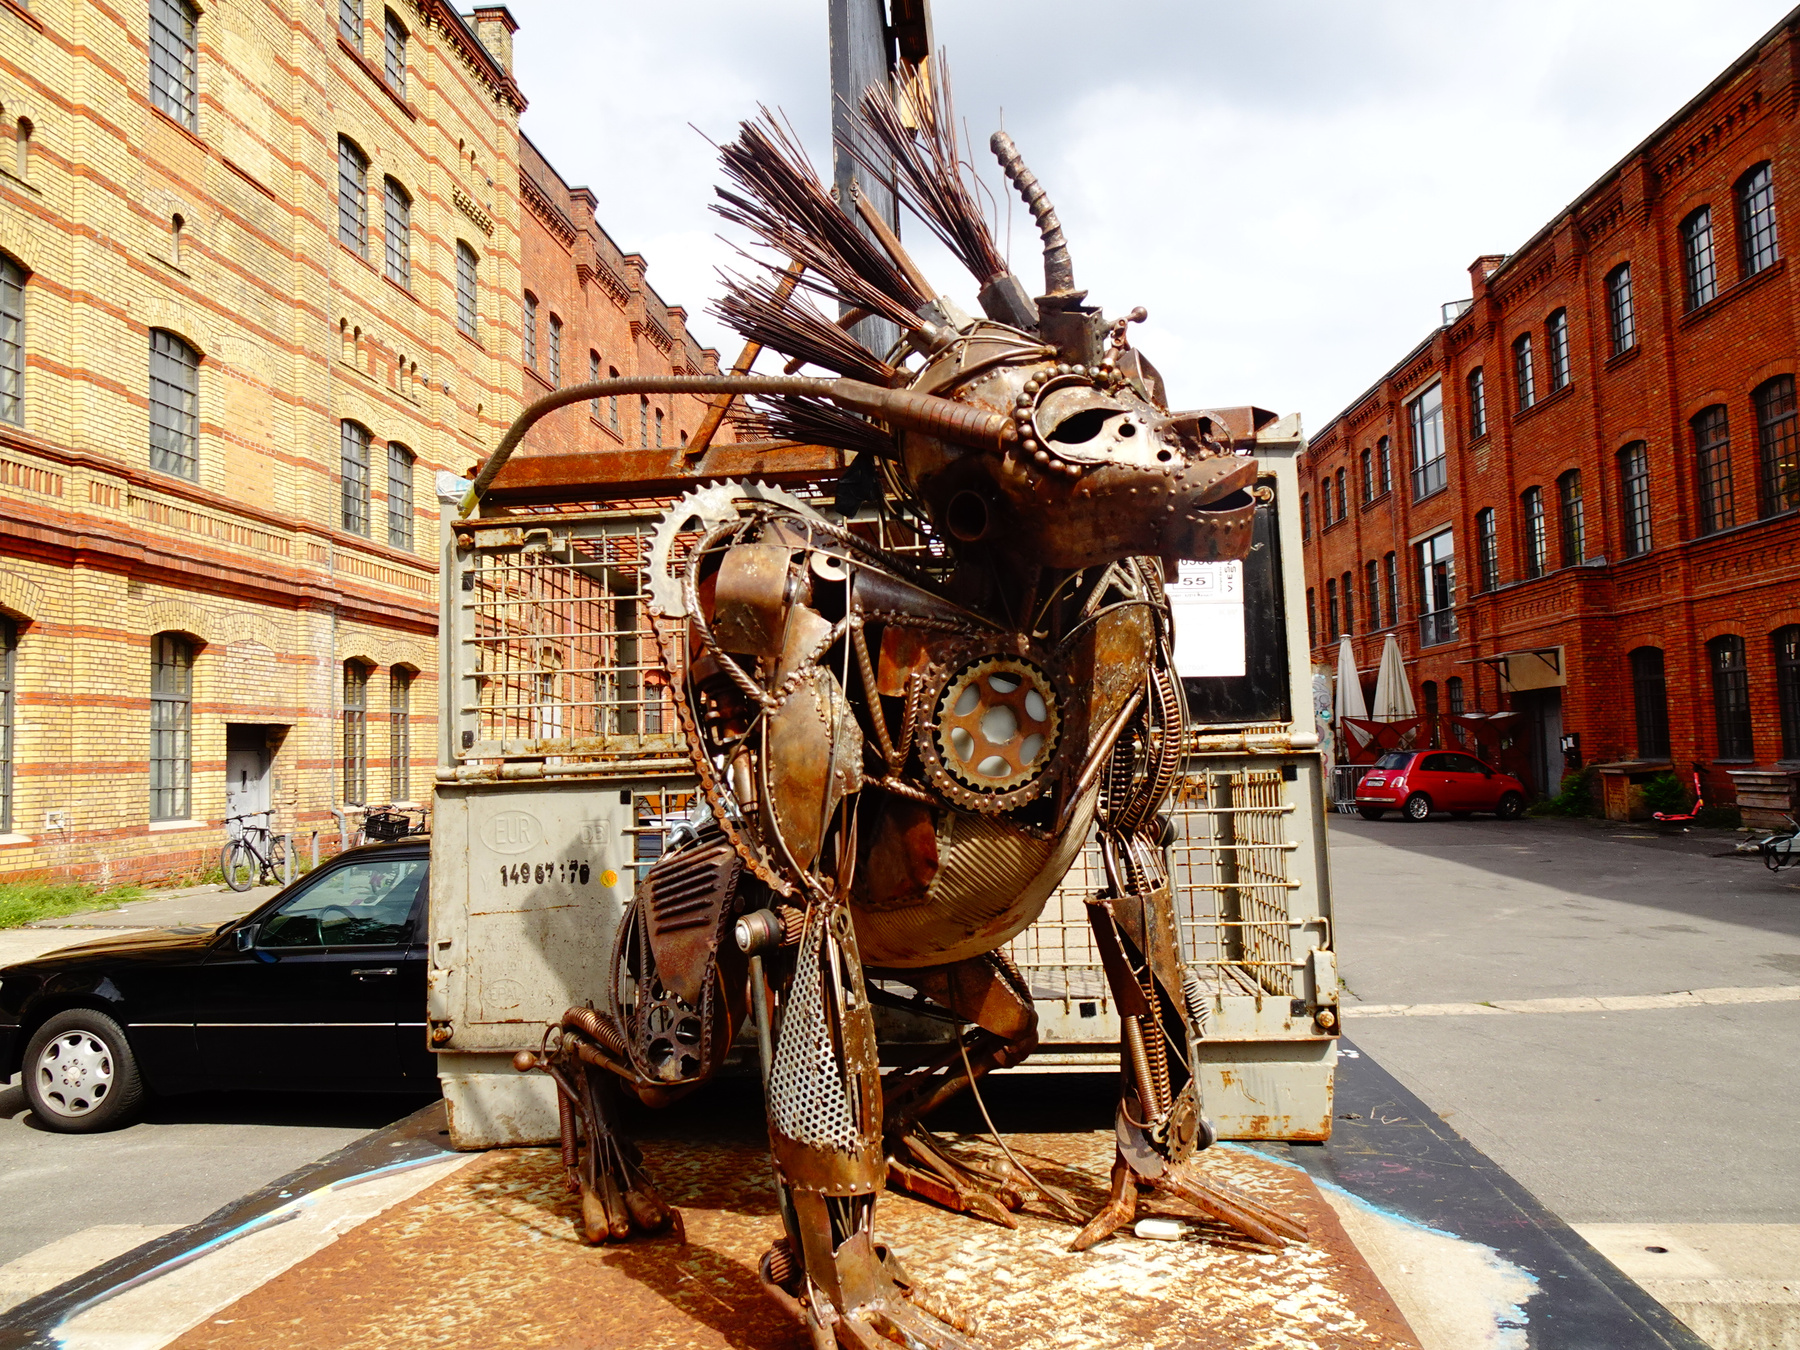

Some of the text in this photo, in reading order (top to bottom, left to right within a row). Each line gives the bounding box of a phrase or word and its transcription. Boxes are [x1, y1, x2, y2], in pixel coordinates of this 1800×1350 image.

[1183, 577, 1206, 586] 55
[494, 816, 531, 845] EUR
[581, 824, 607, 842] DB
[489, 986, 521, 1001] EPAL
